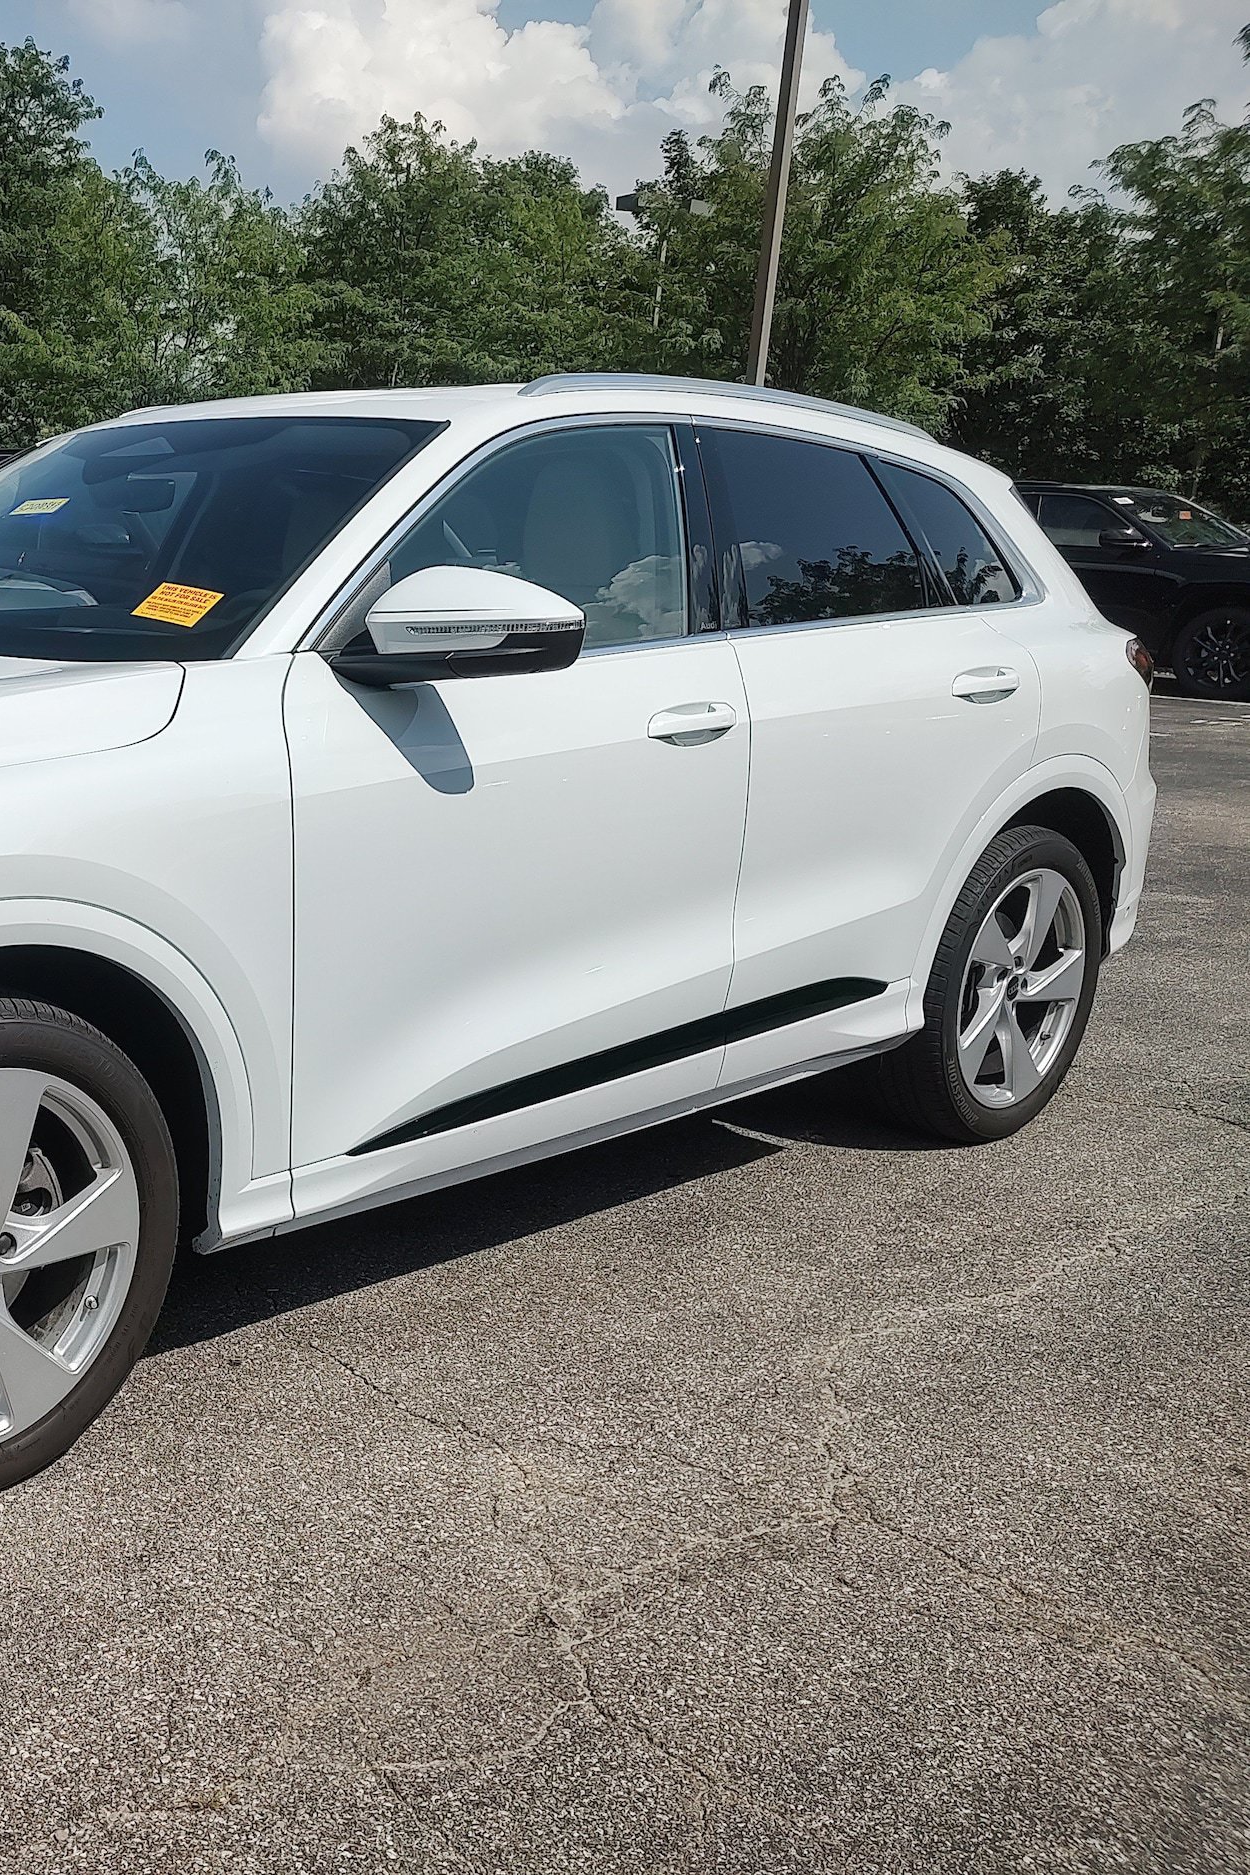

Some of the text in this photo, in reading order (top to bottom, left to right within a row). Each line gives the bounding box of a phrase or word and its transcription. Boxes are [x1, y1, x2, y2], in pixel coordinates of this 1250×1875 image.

[180, 588, 209, 598] VEHICLE
[190, 596, 210, 604] SALE
[701, 620, 718, 630] Audi
[1076, 858, 1101, 925] BRIDGESTON
